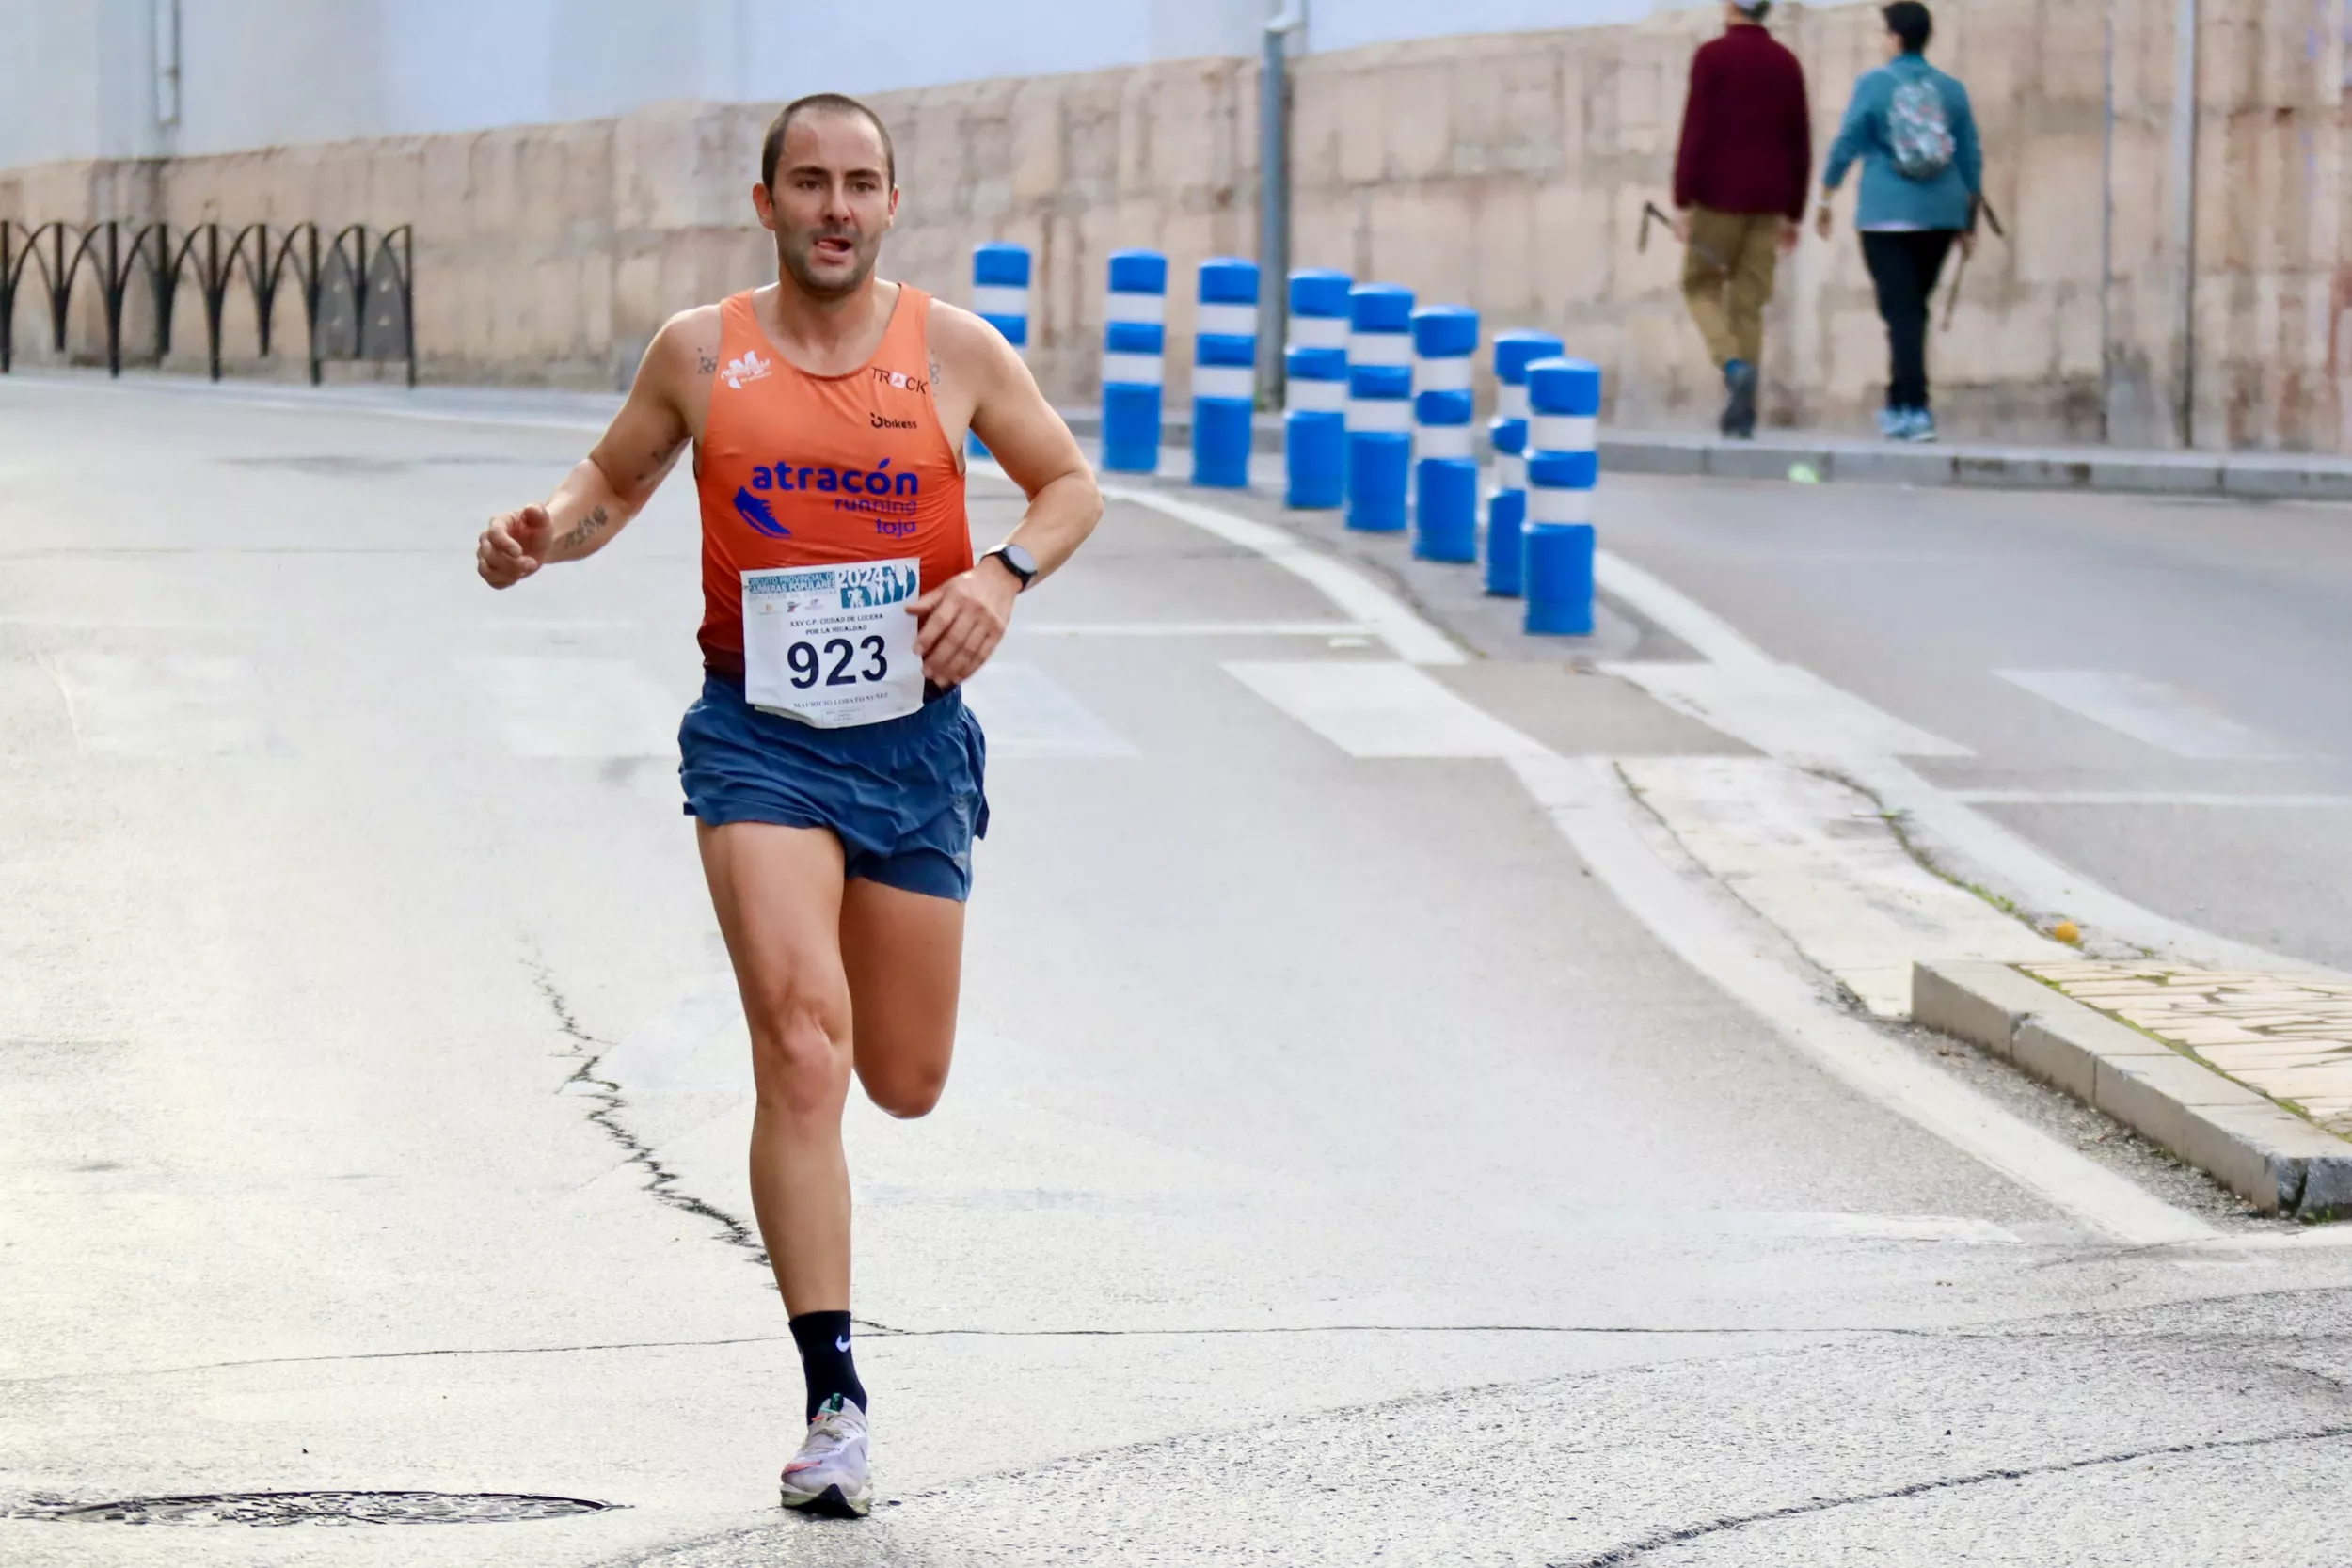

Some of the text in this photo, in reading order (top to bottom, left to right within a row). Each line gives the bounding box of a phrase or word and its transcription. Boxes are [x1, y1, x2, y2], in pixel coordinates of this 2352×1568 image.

[870, 366, 929, 395] TRACK
[752, 457, 918, 496] atracón
[834, 498, 918, 515] running
[876, 518, 916, 538] loja
[779, 573, 824, 584] PROVINCIAL
[789, 580, 836, 592] POPULARES
[838, 566, 886, 589] 2024
[819, 616, 846, 625] CIUDAD
[857, 613, 883, 622] LUCENA
[787, 634, 888, 690] 923
